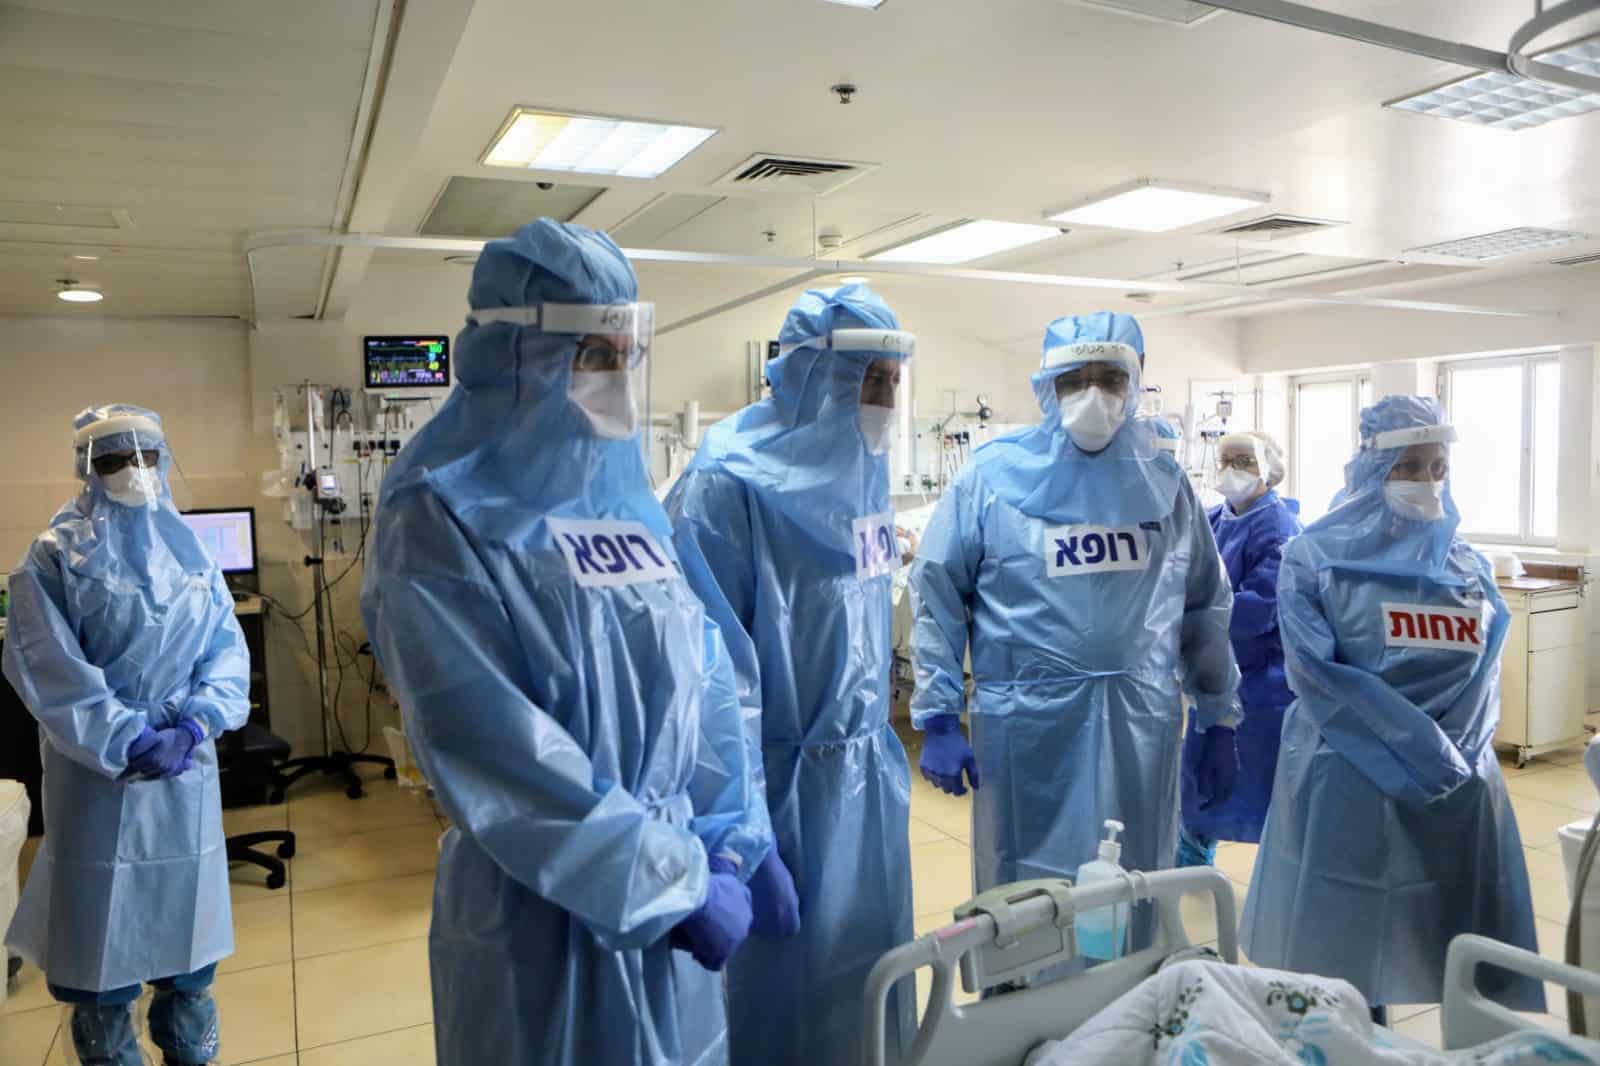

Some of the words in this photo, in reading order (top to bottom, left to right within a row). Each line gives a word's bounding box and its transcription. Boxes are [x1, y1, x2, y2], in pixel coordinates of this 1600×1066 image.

[562, 532, 665, 574] רופא
[1055, 532, 1139, 567] רופא
[1389, 611, 1480, 644] אחות
